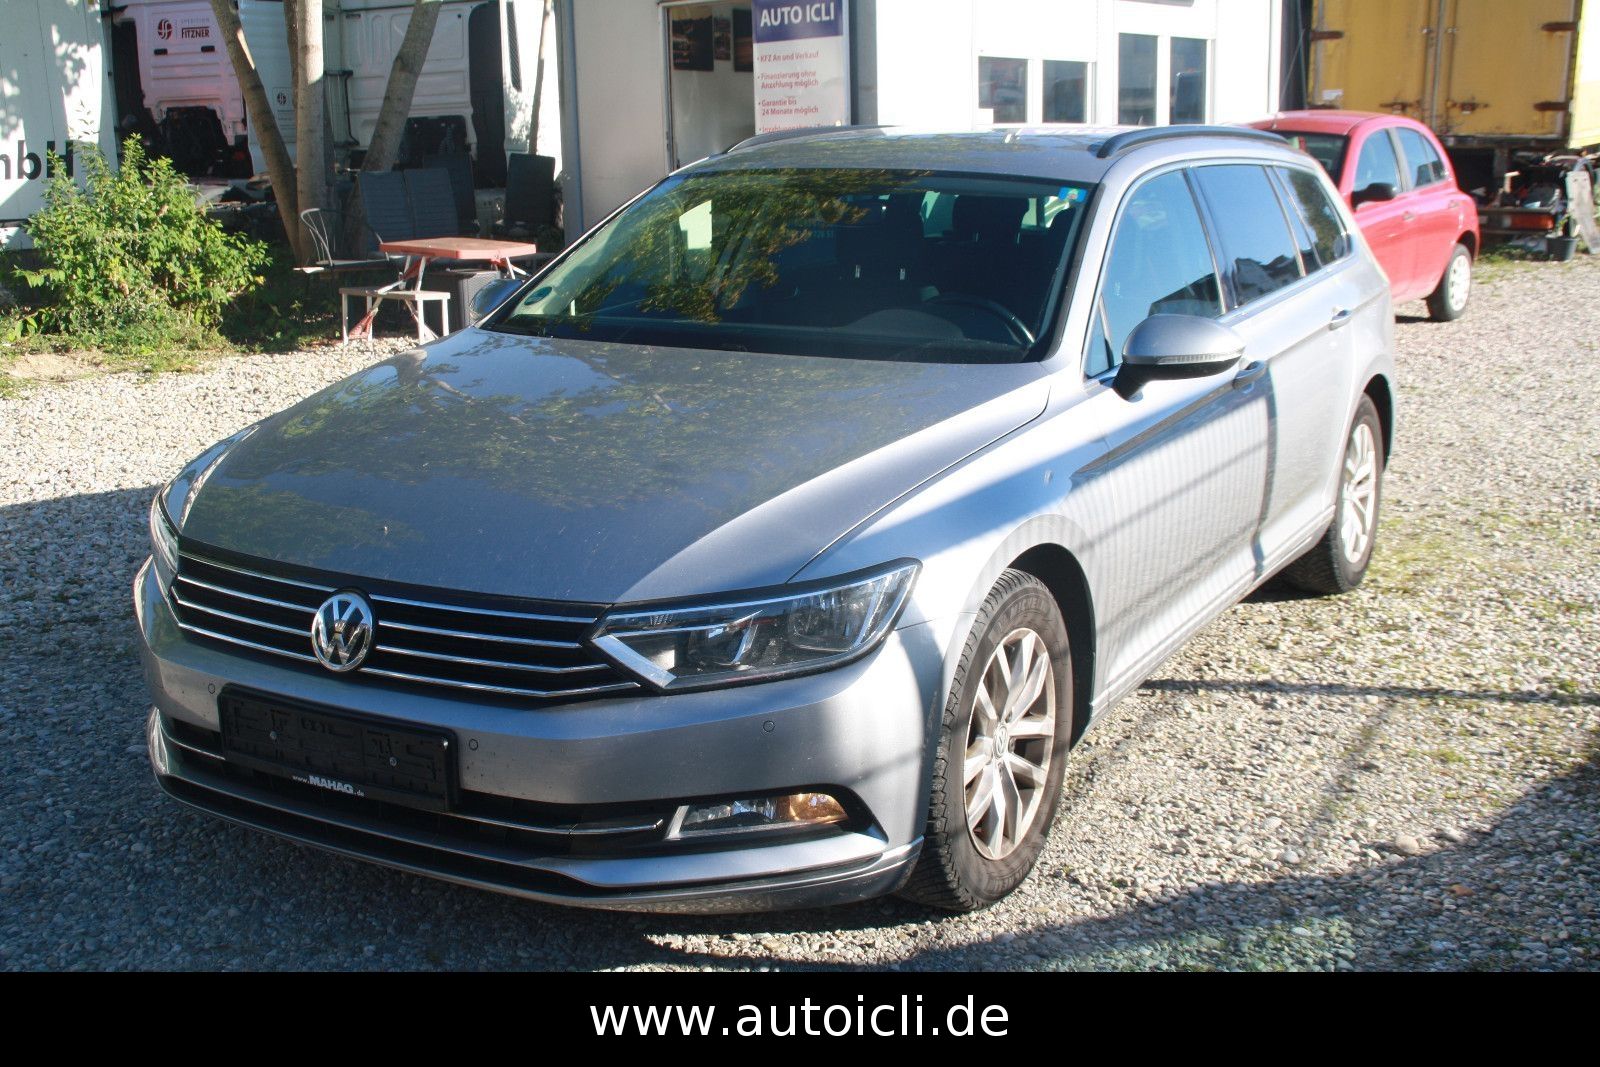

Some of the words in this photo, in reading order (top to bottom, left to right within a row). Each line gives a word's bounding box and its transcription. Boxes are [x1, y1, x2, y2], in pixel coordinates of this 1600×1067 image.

[760, 5, 803, 27] AUTO
[806, 2, 835, 22] ICLI
[181, 26, 210, 39] FITZNER
[782, 53, 794, 61] und
